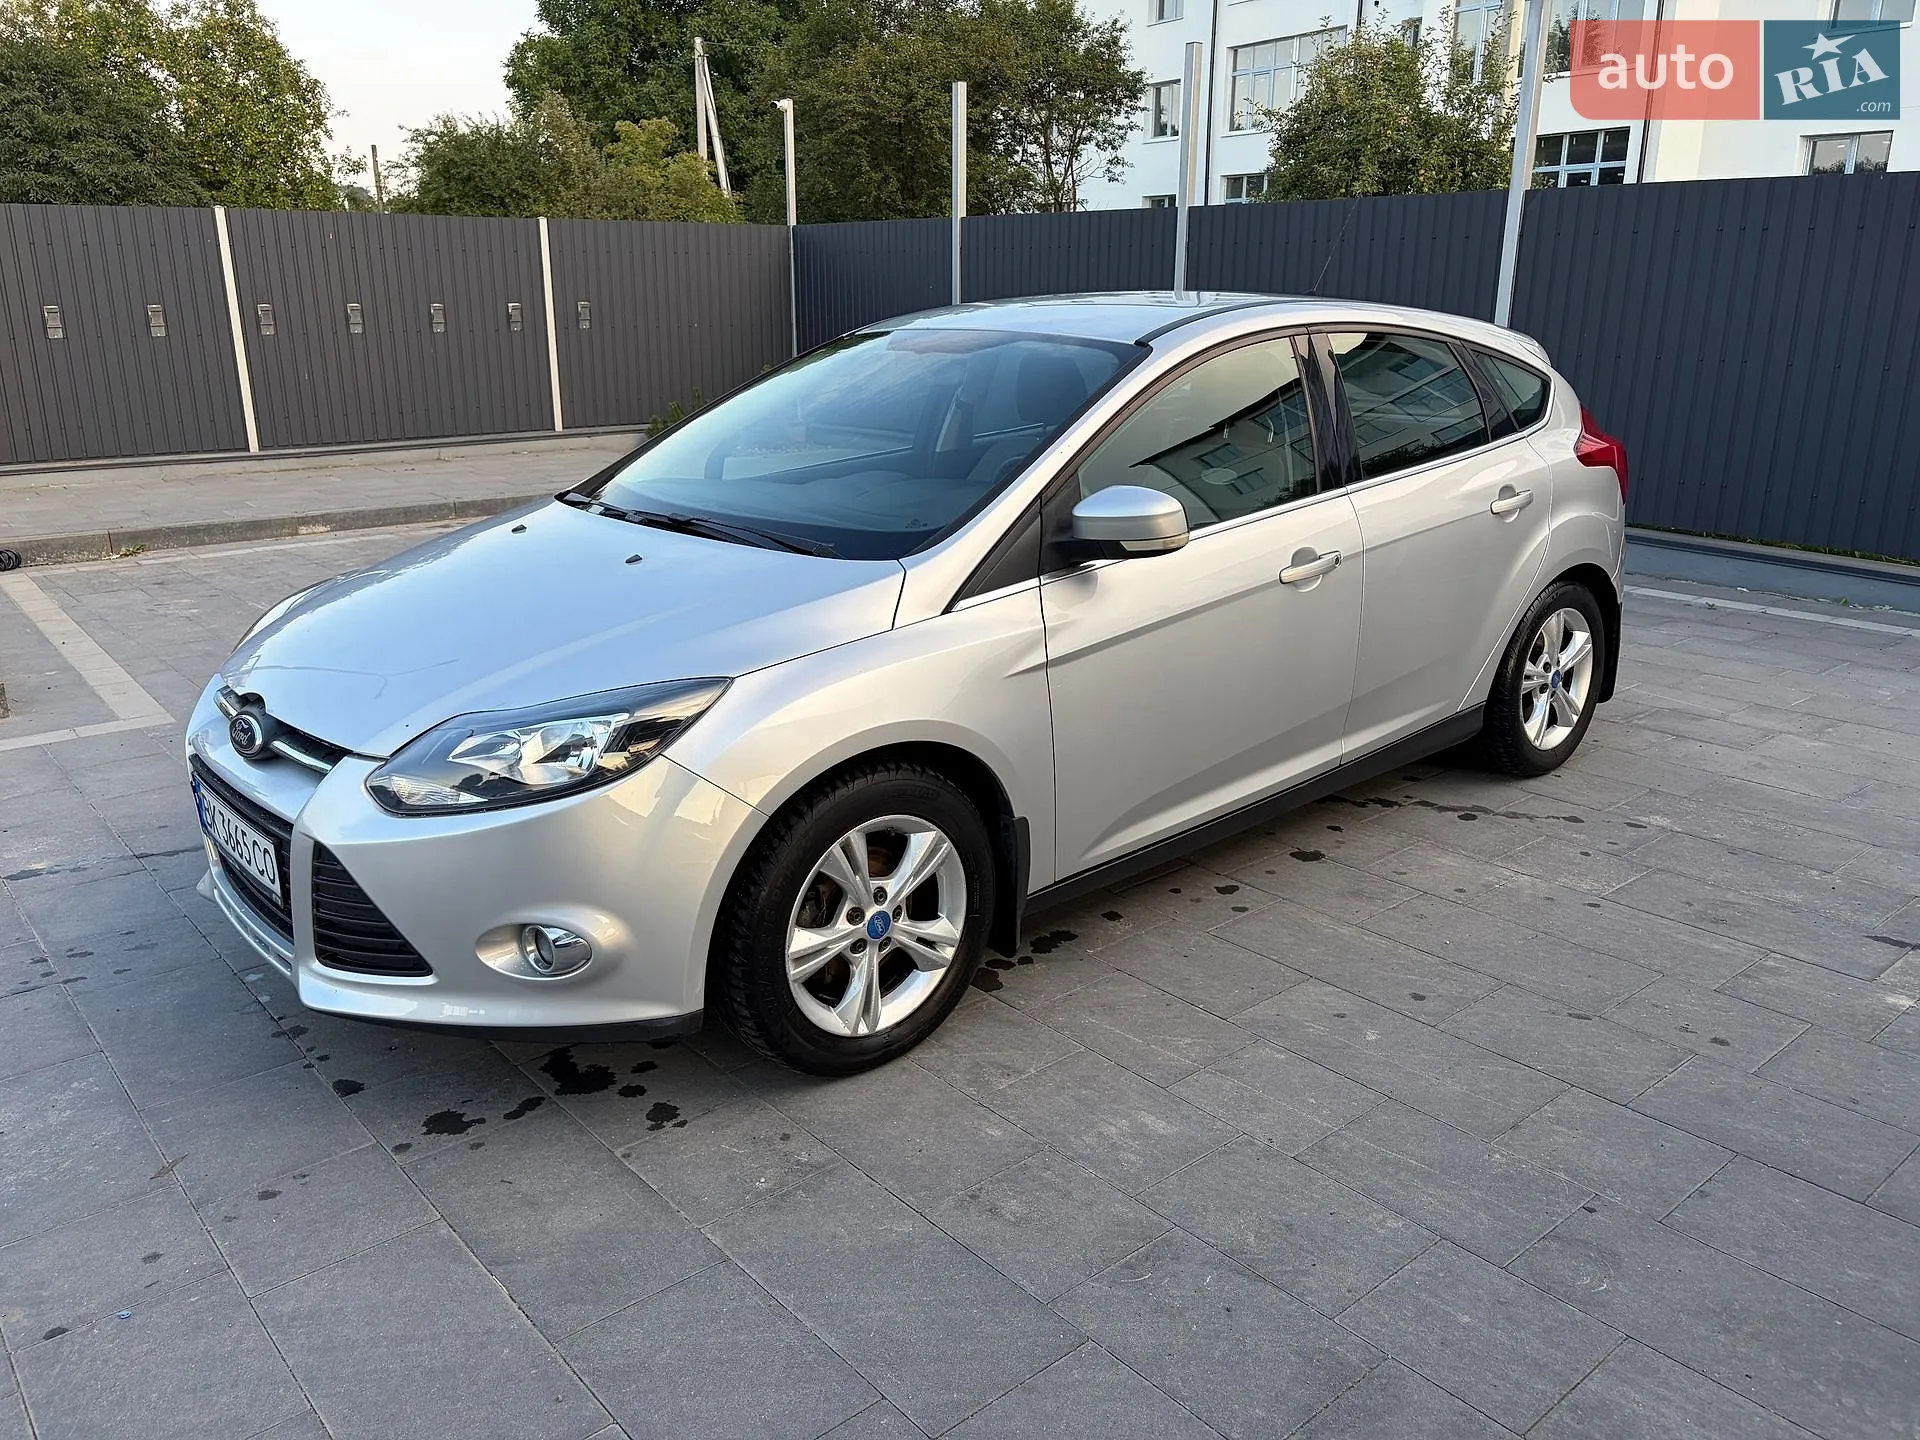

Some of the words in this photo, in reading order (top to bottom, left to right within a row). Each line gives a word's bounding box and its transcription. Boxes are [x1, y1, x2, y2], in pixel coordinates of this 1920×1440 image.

[232, 720, 251, 745] Ford
[218, 809, 251, 866] 3665
[252, 840, 275, 884] CO
